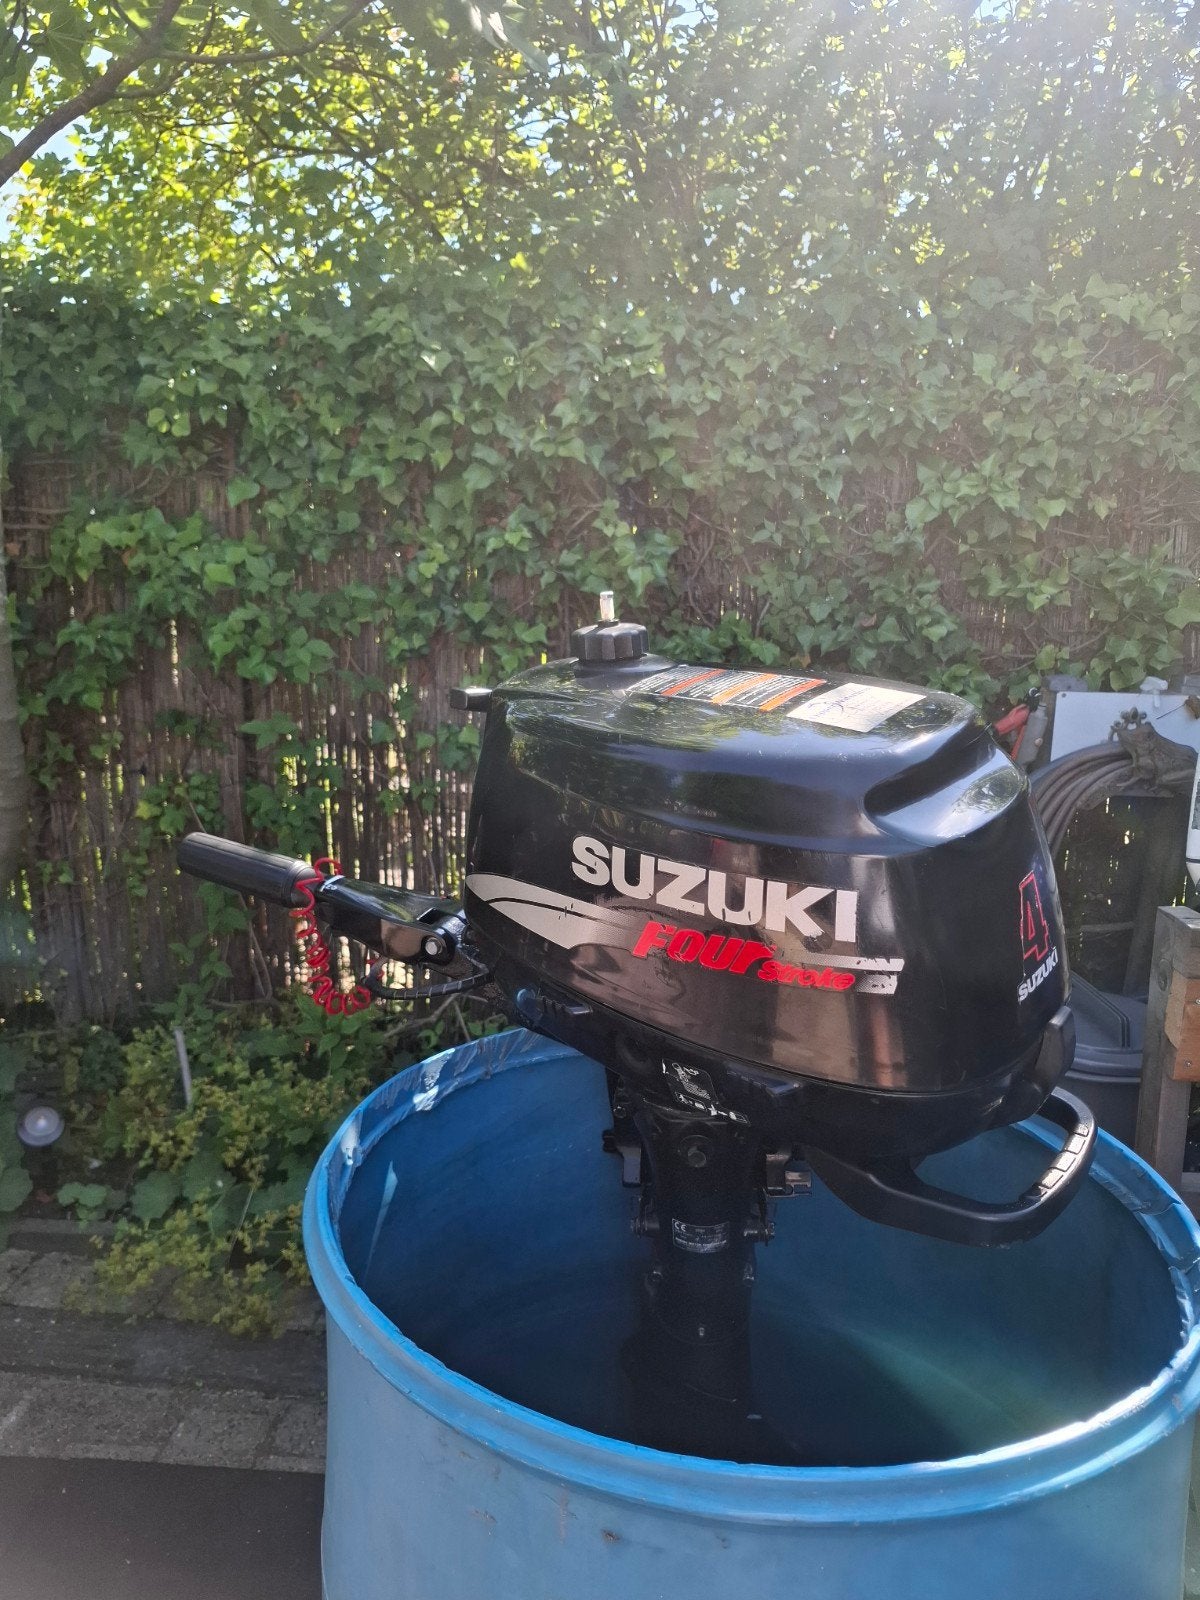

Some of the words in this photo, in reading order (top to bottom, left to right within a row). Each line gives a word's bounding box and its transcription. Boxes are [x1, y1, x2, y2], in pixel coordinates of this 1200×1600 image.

[571, 835, 859, 943] SUZUKI
[1018, 869, 1049, 961] 4
[1018, 947, 1058, 1003] SUZUKI
